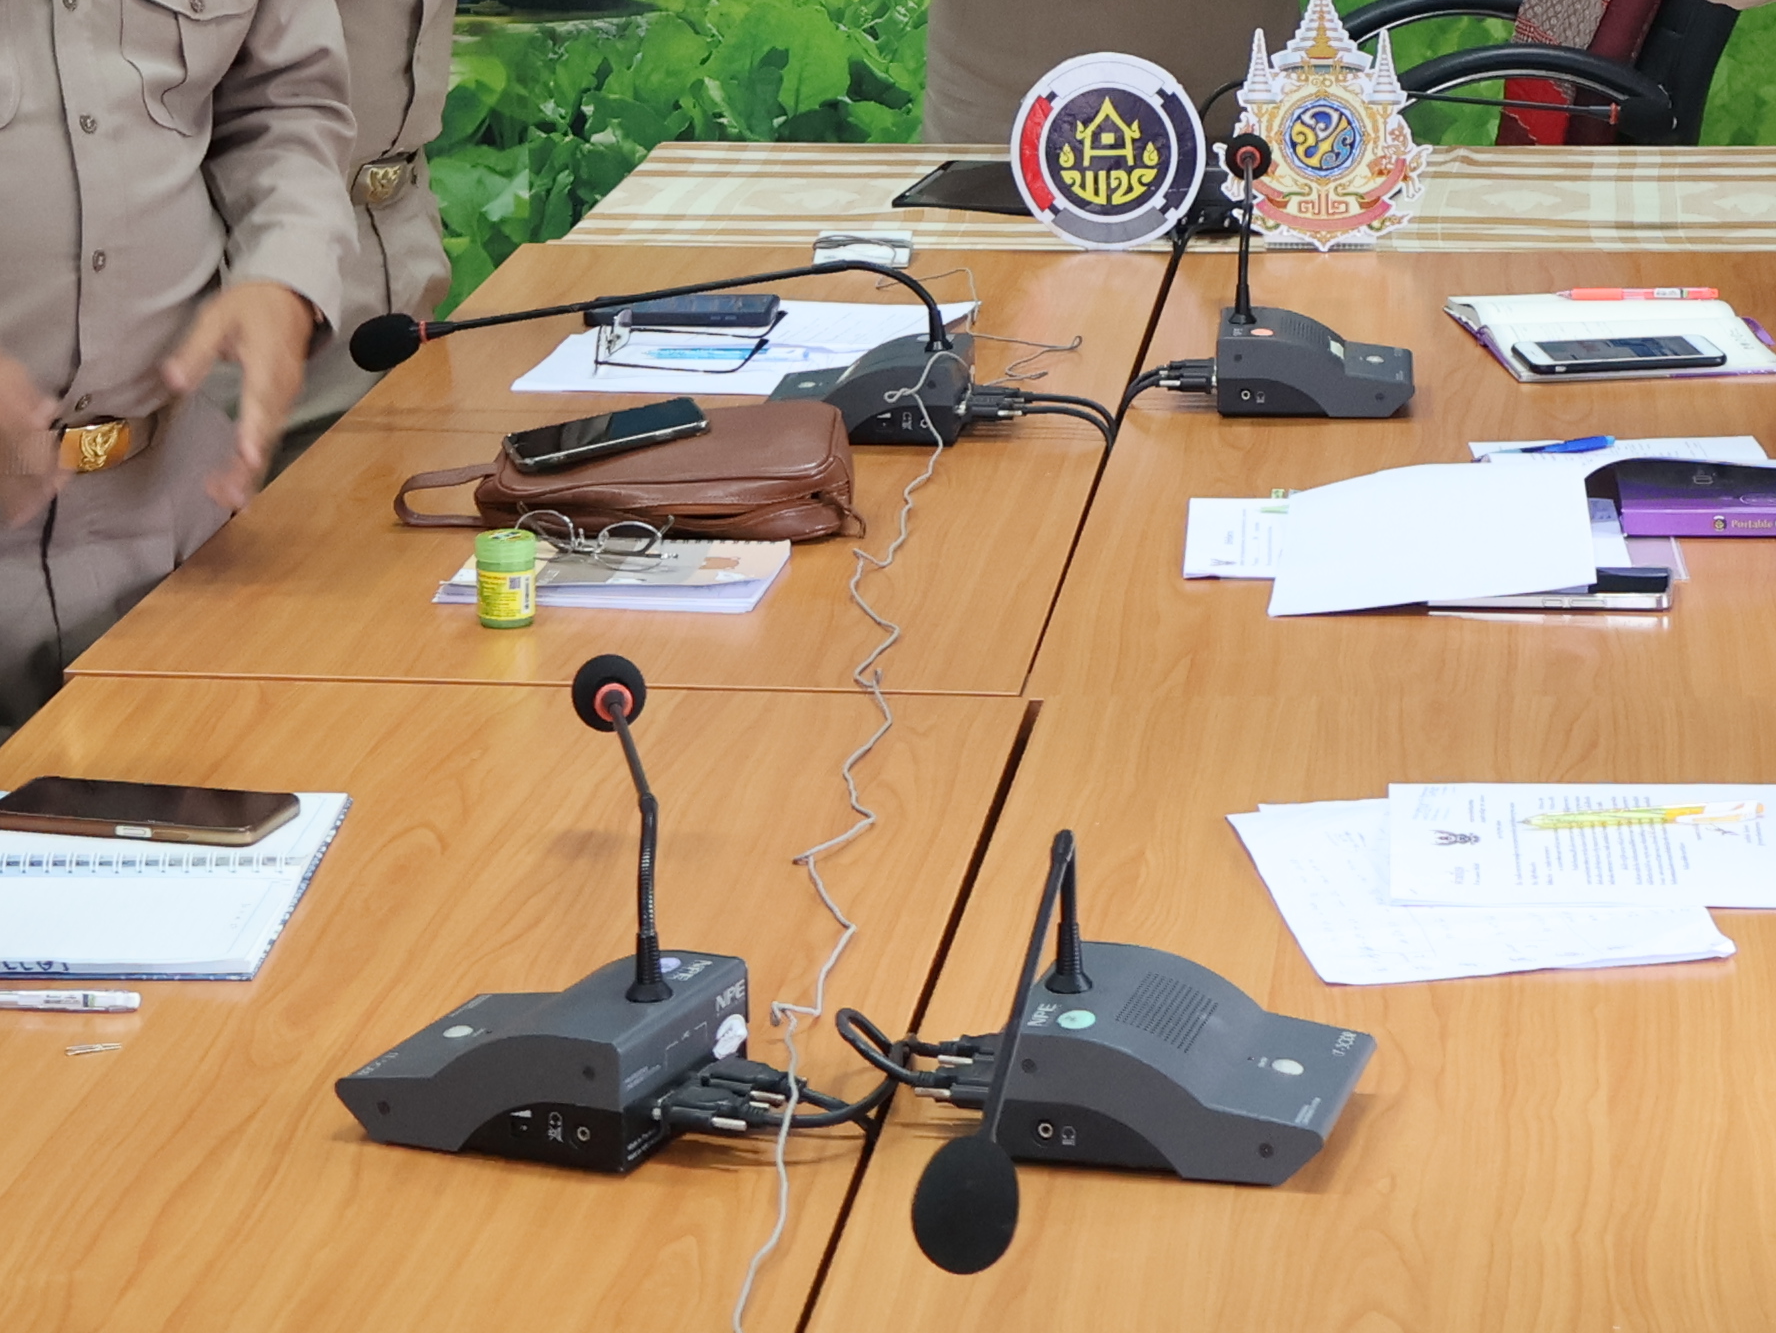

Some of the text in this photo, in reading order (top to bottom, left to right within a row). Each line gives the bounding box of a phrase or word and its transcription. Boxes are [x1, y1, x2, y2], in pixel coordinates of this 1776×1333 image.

[1731, 519, 1773, 530] Portable
[715, 978, 746, 1013] NPE
[1026, 1002, 1058, 1028] NPE
